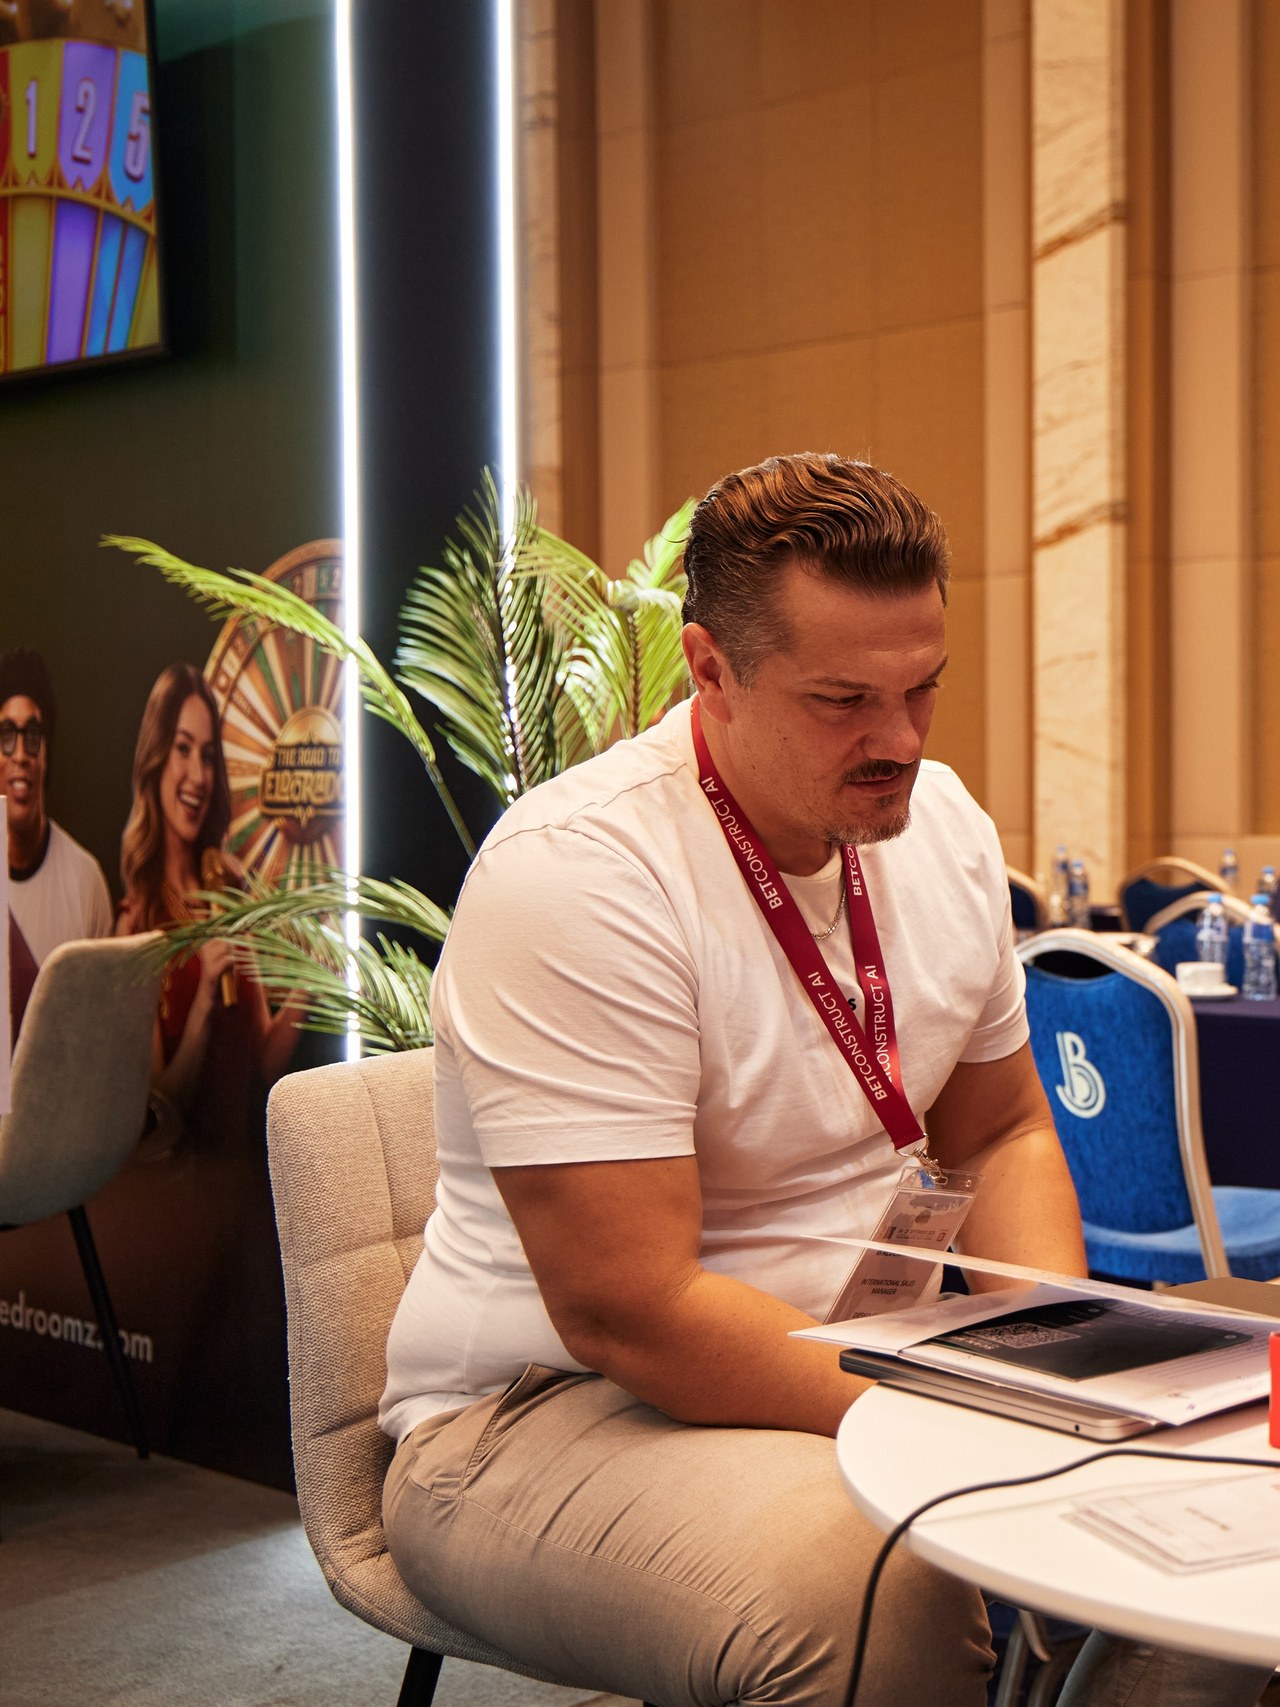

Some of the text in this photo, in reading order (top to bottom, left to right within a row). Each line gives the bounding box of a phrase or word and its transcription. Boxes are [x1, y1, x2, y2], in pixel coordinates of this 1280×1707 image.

[24, 76, 150, 181] 1 2 5
[701, 776, 784, 910] BETCONSTRUCT AI
[864, 964, 879, 980] AI
[807, 971, 888, 1101] BETCONSTRUCT AI
[861, 1278, 916, 1287] INTERNATIONAL SALES
[871, 1287, 898, 1295] MANAGER
